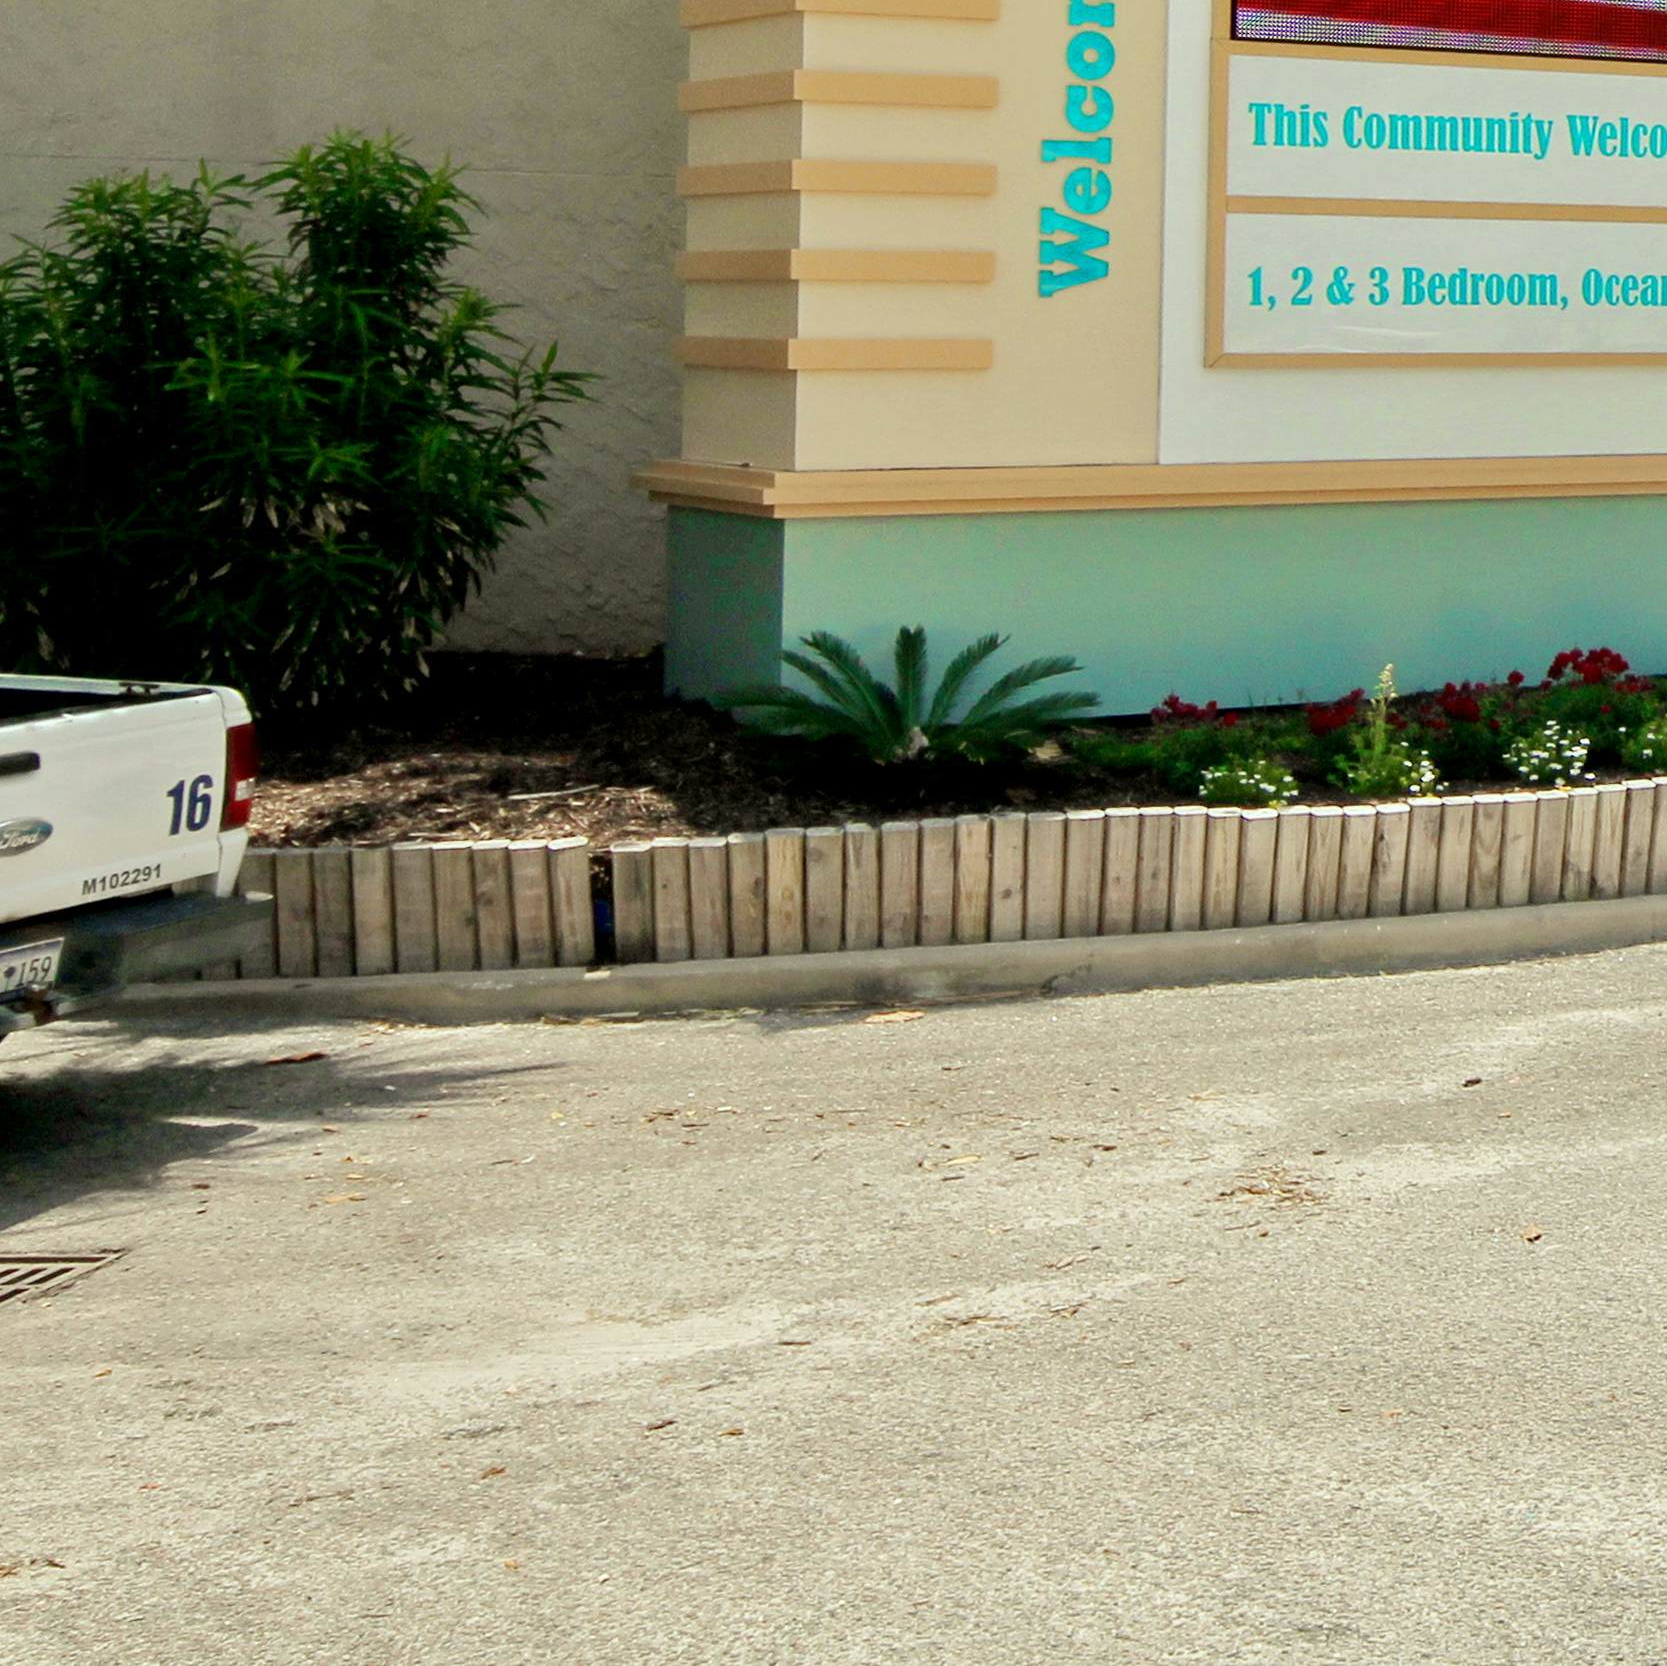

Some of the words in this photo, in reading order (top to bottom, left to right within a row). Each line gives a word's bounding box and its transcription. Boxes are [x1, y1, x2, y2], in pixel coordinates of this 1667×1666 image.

[1247, 101, 1330, 149] This
[1342, 108, 1554, 161] Community
[1246, 266, 1277, 310] 1,
[1289, 265, 1314, 307] 2
[1326, 265, 1357, 306] &
[1367, 266, 1391, 307] 3
[1402, 266, 1569, 310] Bedroom,
[166, 774, 214, 836] 16
[81, 863, 163, 896] M102291
